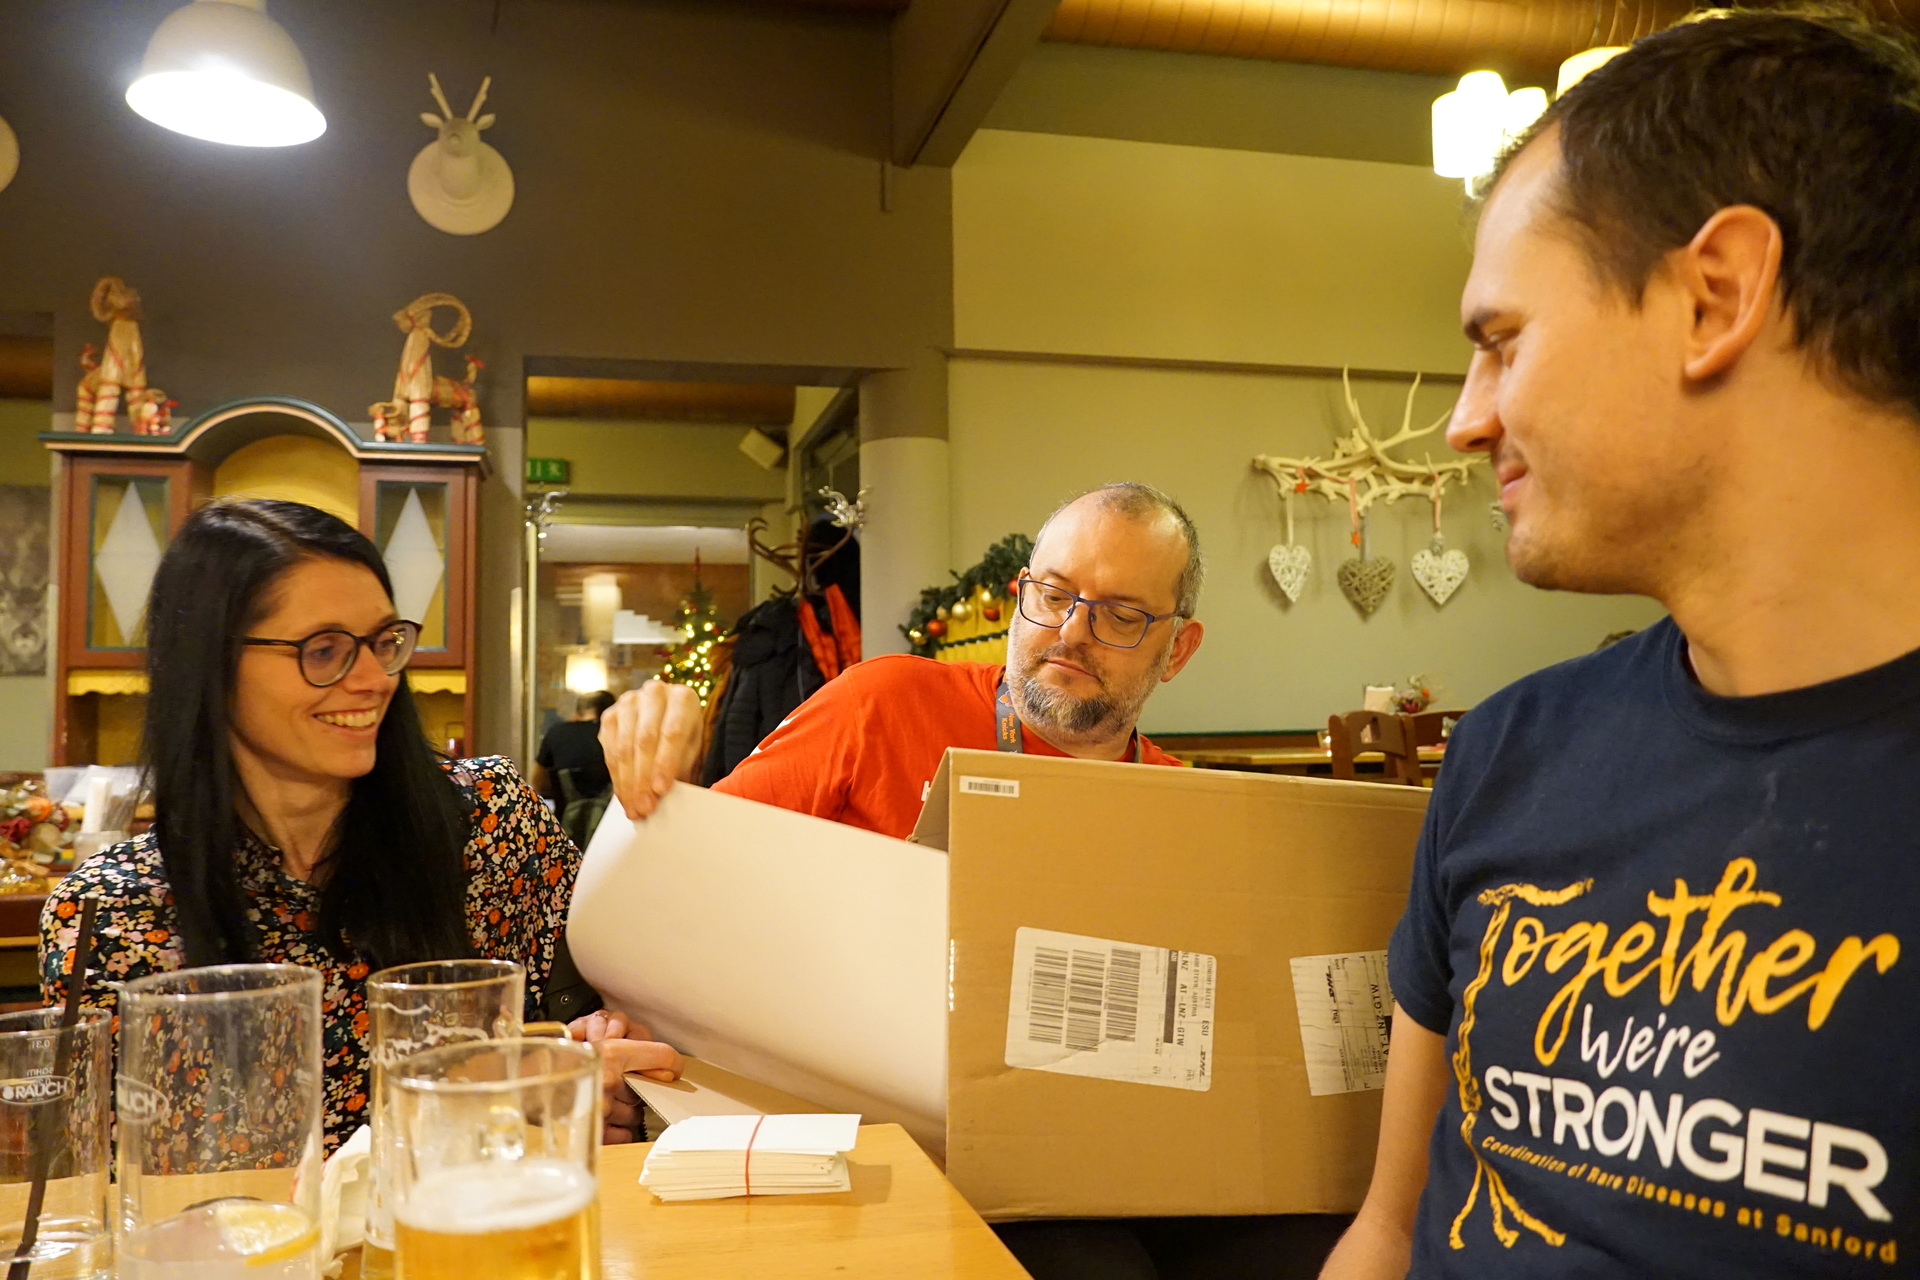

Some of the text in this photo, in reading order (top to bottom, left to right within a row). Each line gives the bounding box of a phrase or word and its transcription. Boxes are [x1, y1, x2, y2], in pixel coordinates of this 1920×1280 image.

[1001, 717, 1009, 740] Knicks
[1009, 728, 1017, 744] York
[1477, 857, 1900, 1066] Together
[1200, 1020, 1210, 1036] ESU
[1581, 1003, 1720, 1079] We're
[15, 1080, 68, 1099] RAUCH
[1484, 1065, 1893, 1223] STRONGER
[1481, 1135, 1898, 1265] Coordination of Rare Diseases at Sanford
